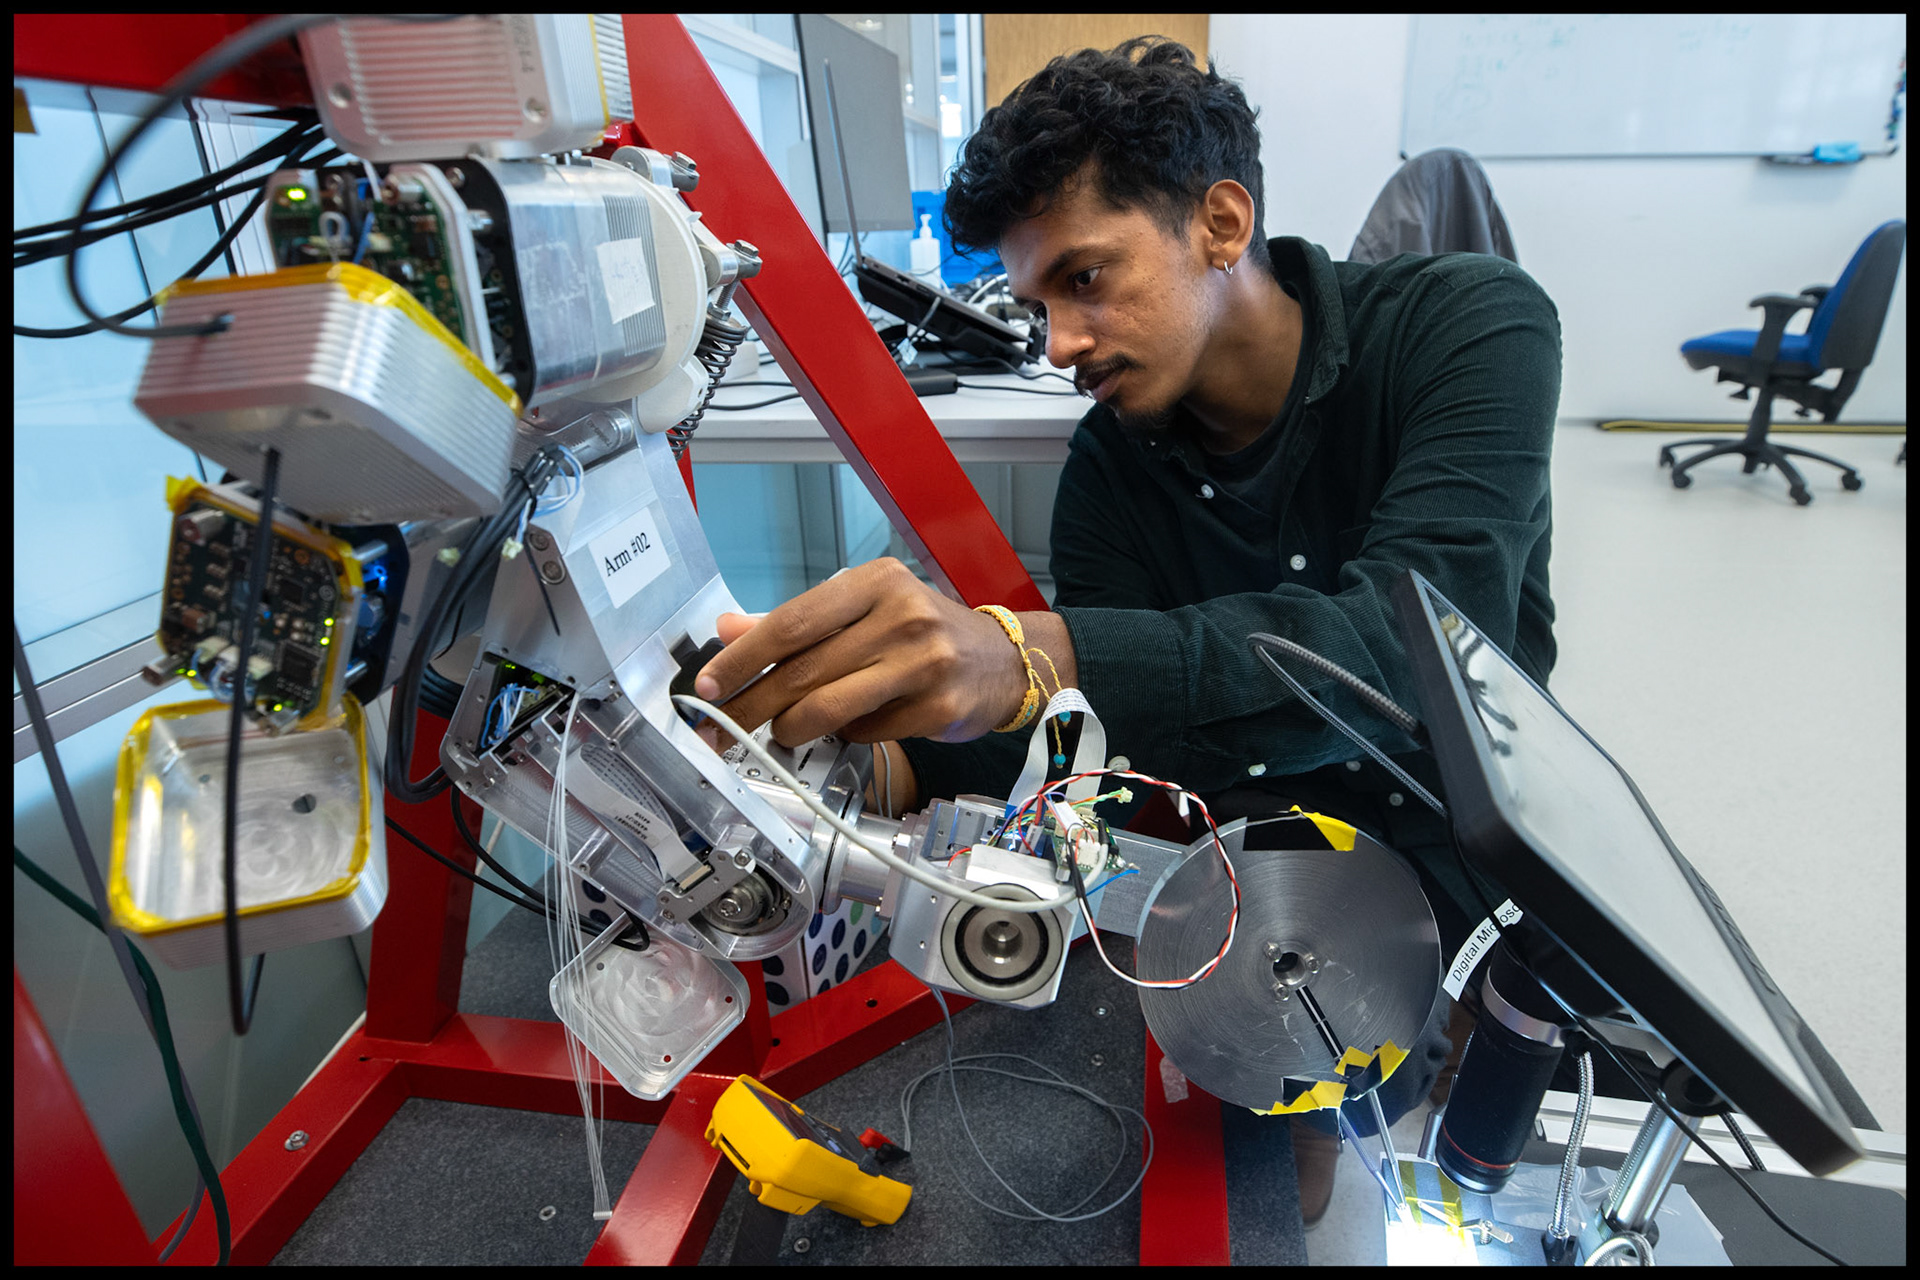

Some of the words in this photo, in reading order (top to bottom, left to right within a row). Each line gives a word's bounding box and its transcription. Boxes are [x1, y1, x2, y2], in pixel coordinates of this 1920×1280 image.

[604, 549, 632, 577] Arm
[630, 532, 651, 557] #02
[1452, 942, 1480, 982] Digital
